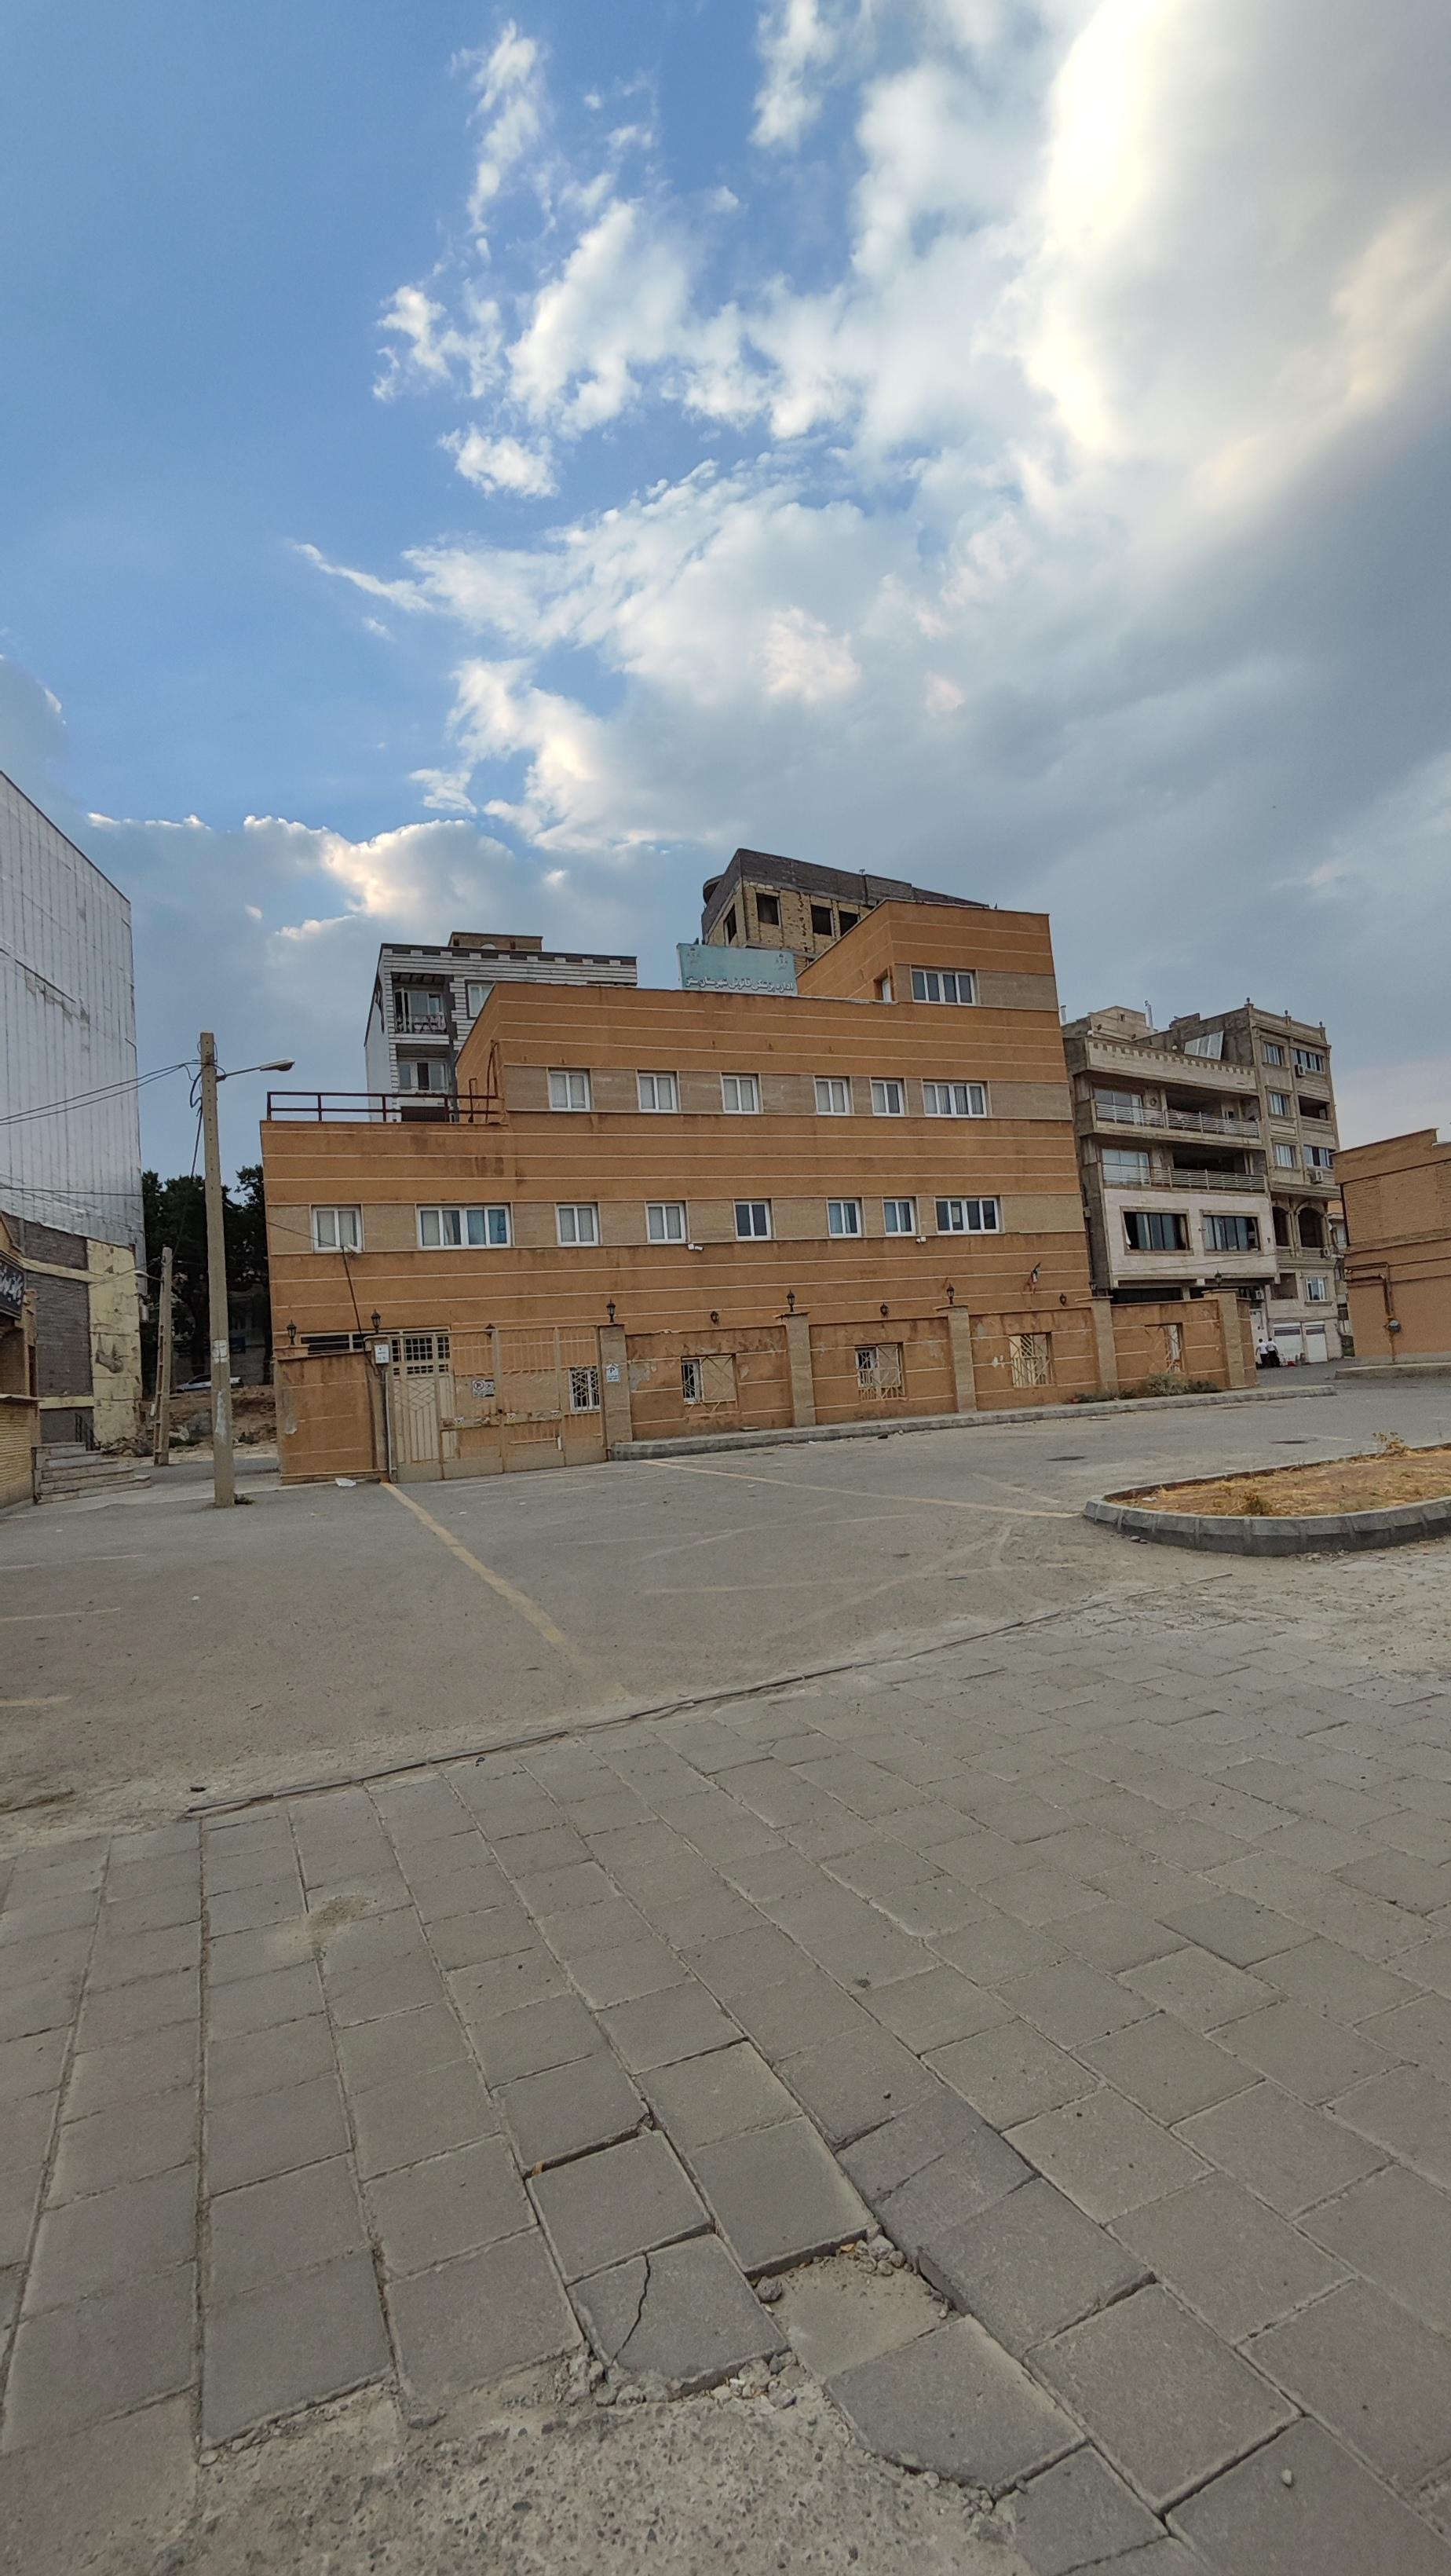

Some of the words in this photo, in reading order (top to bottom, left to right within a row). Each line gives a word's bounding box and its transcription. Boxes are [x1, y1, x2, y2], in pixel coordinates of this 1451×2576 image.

[699, 976, 728, 989] شهرستان
[729, 977, 751, 990] قانونی
[751, 979, 775, 993] پزشکی
[776, 981, 793, 993] اداره
